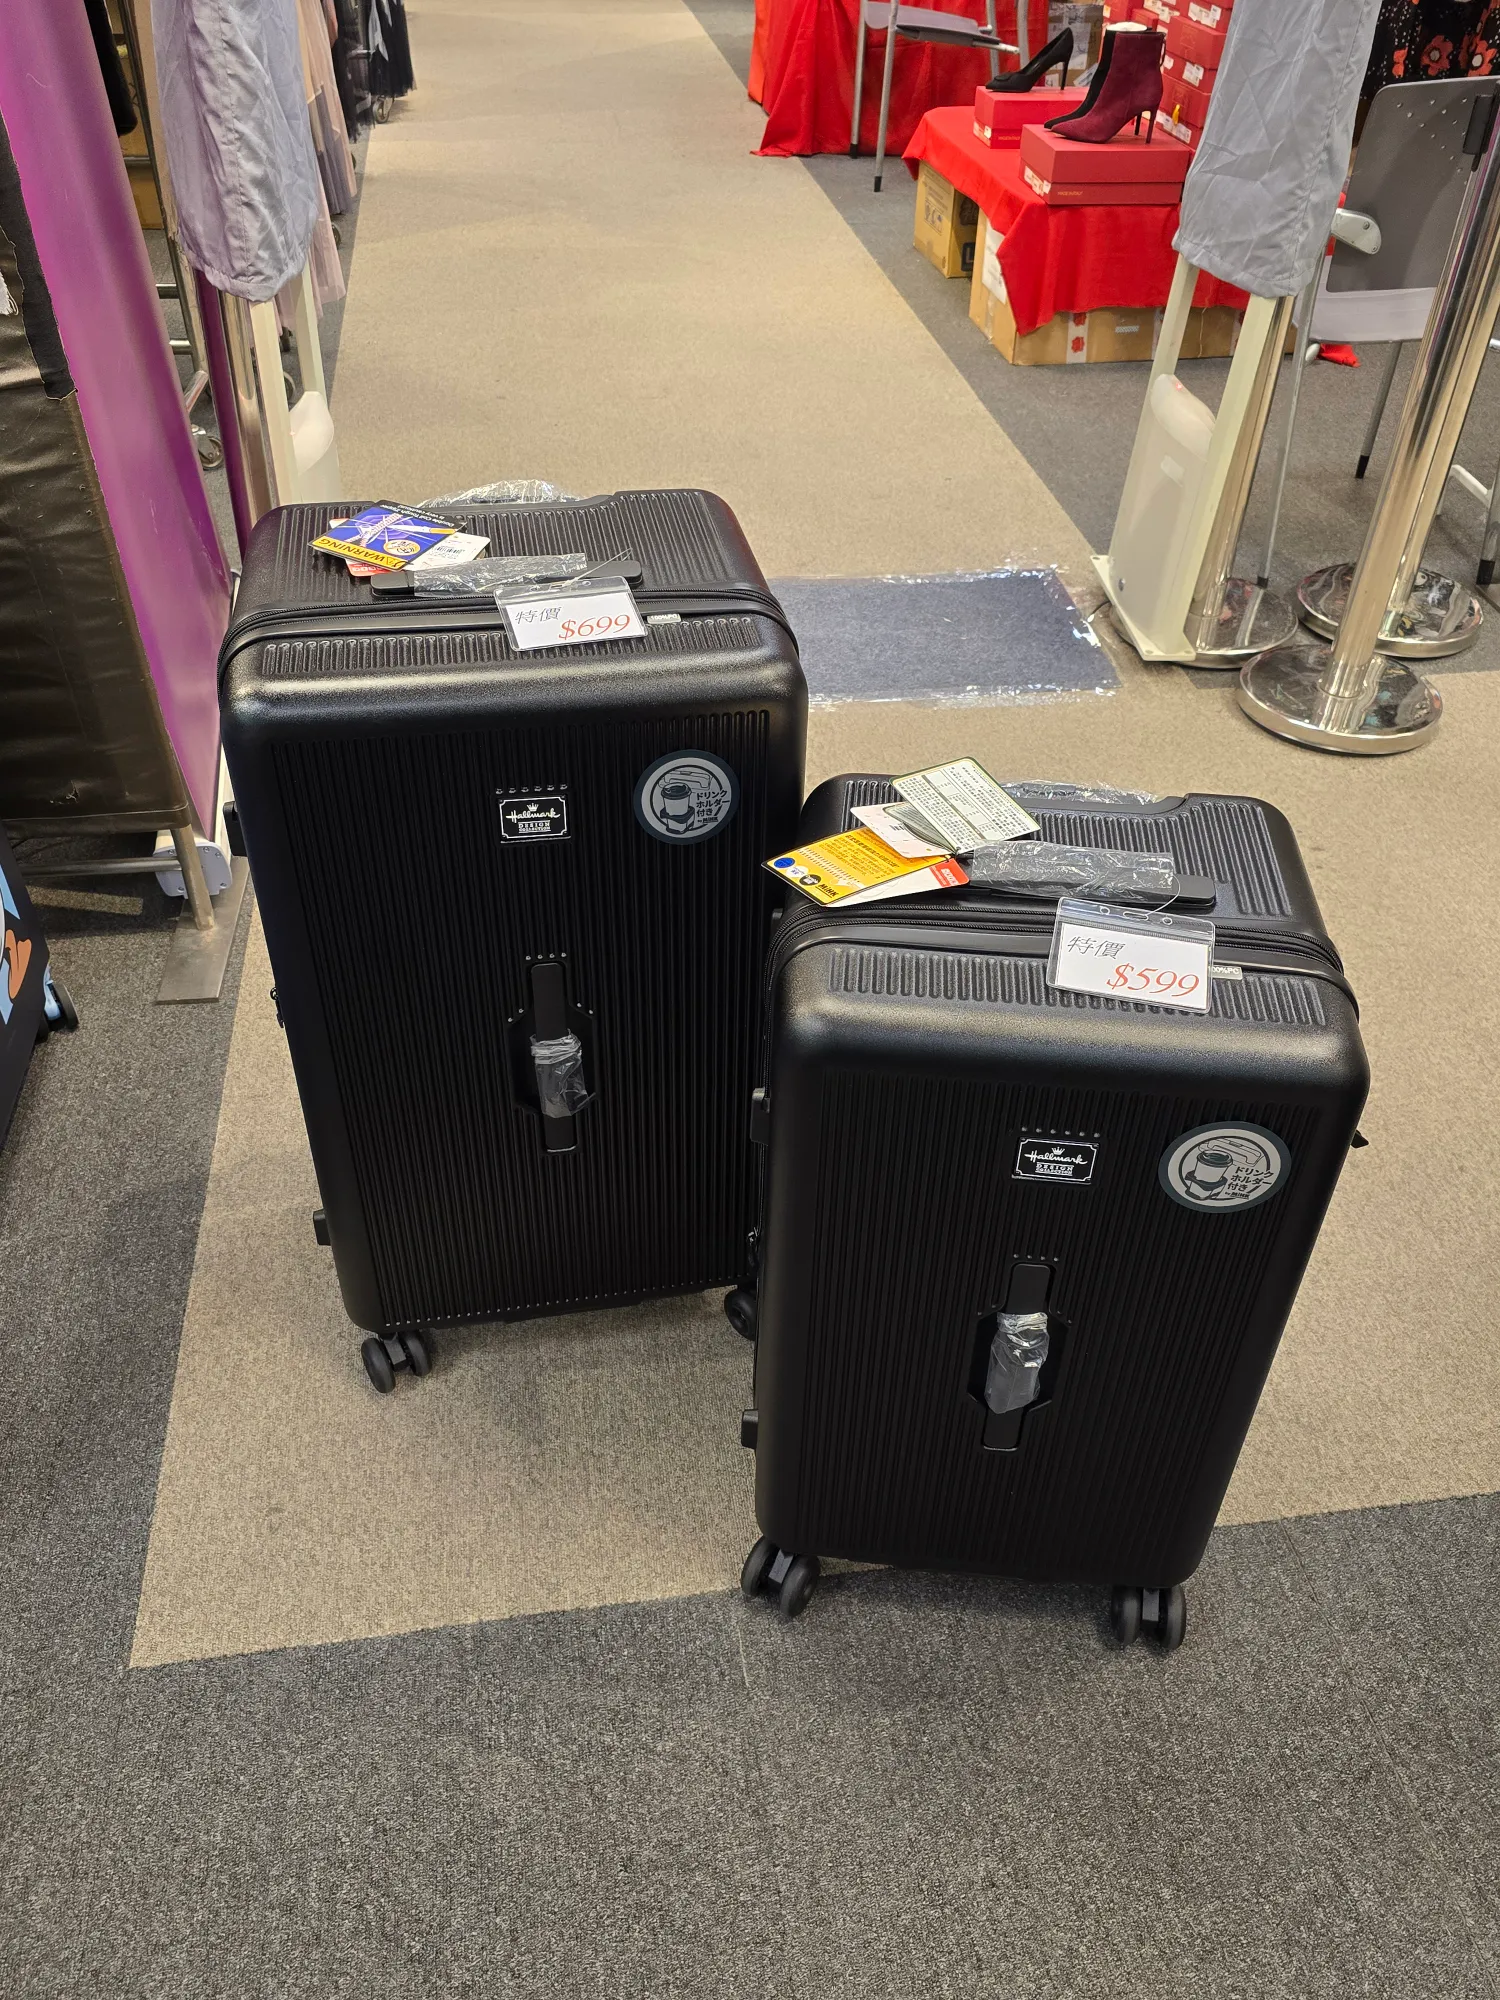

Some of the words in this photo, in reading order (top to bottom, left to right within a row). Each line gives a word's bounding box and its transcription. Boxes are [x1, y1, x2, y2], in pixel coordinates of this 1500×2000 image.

[319, 538, 385, 562] WARNING
[515, 606, 562, 624] 特價
[558, 614, 631, 640] $699
[696, 790, 728, 801] ドリンク
[696, 798, 730, 808] ホルダー
[505, 807, 561, 824] Hallmark
[696, 808, 714, 817] 付き
[1067, 936, 1126, 960] 特價
[1106, 962, 1200, 997] $599
[1024, 1149, 1088, 1165] Hallmark
[1231, 1174, 1272, 1185] ホルダー
[1235, 1166, 1274, 1178] ドリンク
[1227, 1182, 1248, 1192] 付き
